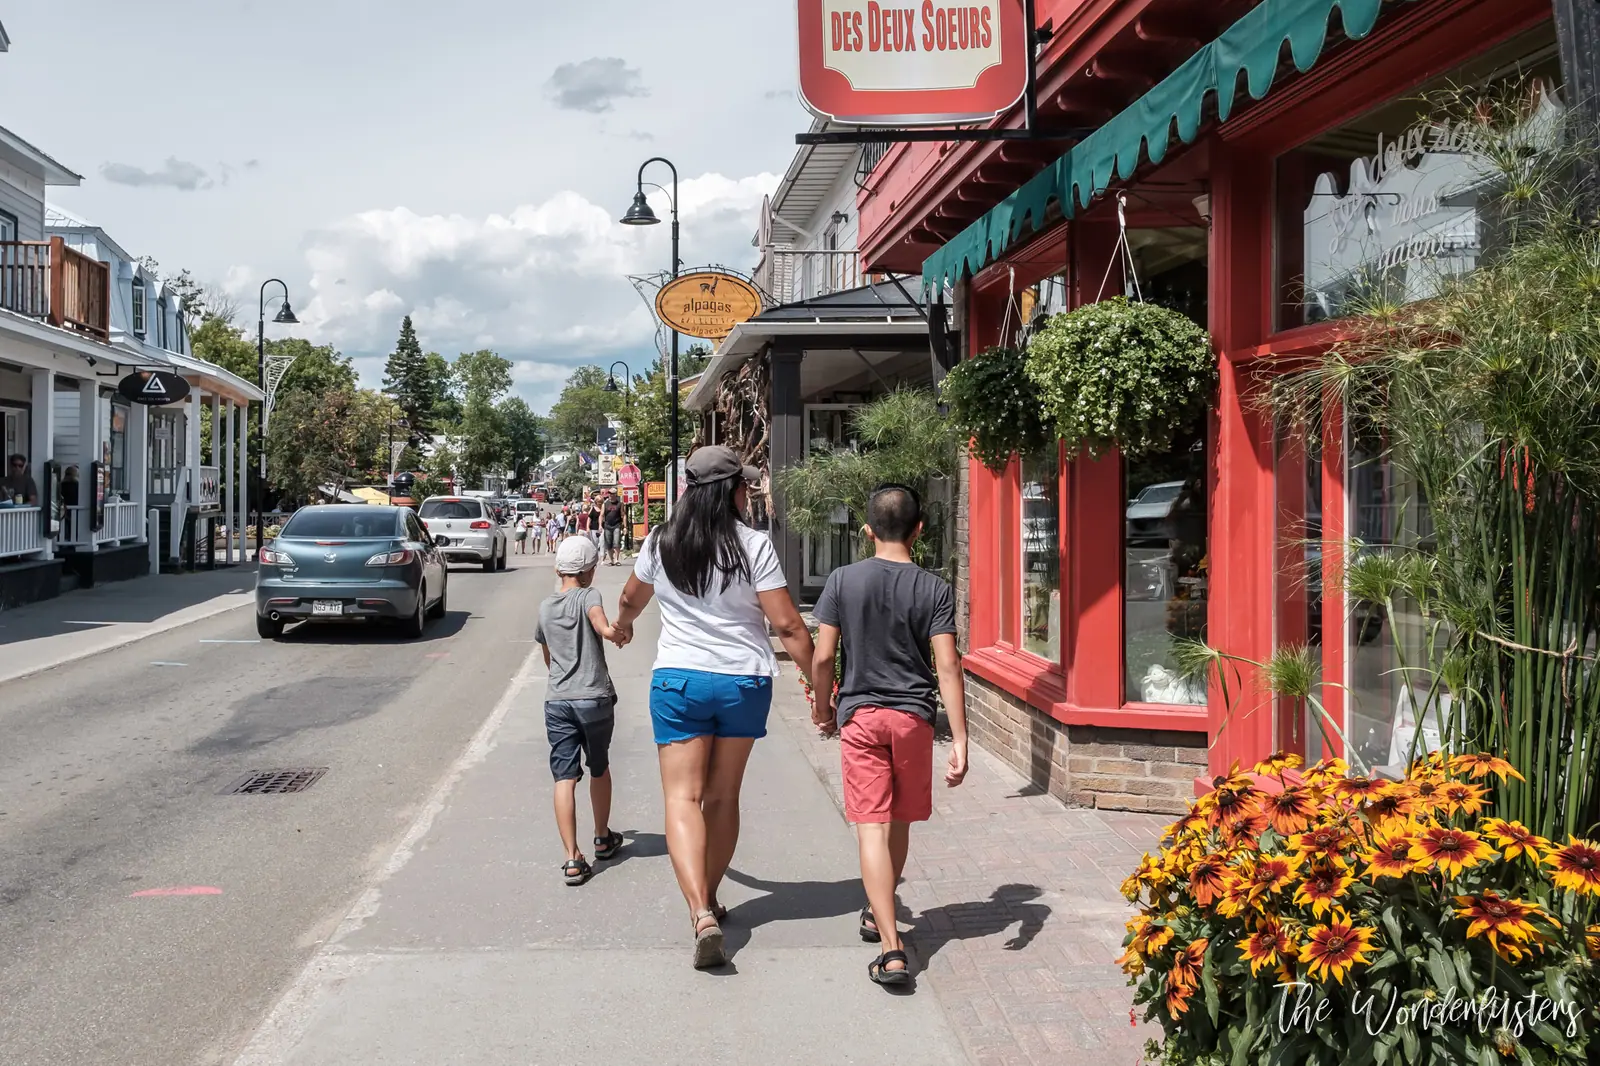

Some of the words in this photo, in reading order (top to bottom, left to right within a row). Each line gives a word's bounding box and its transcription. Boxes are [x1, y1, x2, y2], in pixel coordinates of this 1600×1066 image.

[831, 11, 863, 52] DES
[867, 1, 916, 52] DEUX
[921, 0, 992, 52] SOEURS
[683, 298, 732, 313] alpagas
[691, 326, 725, 335] alpacas
